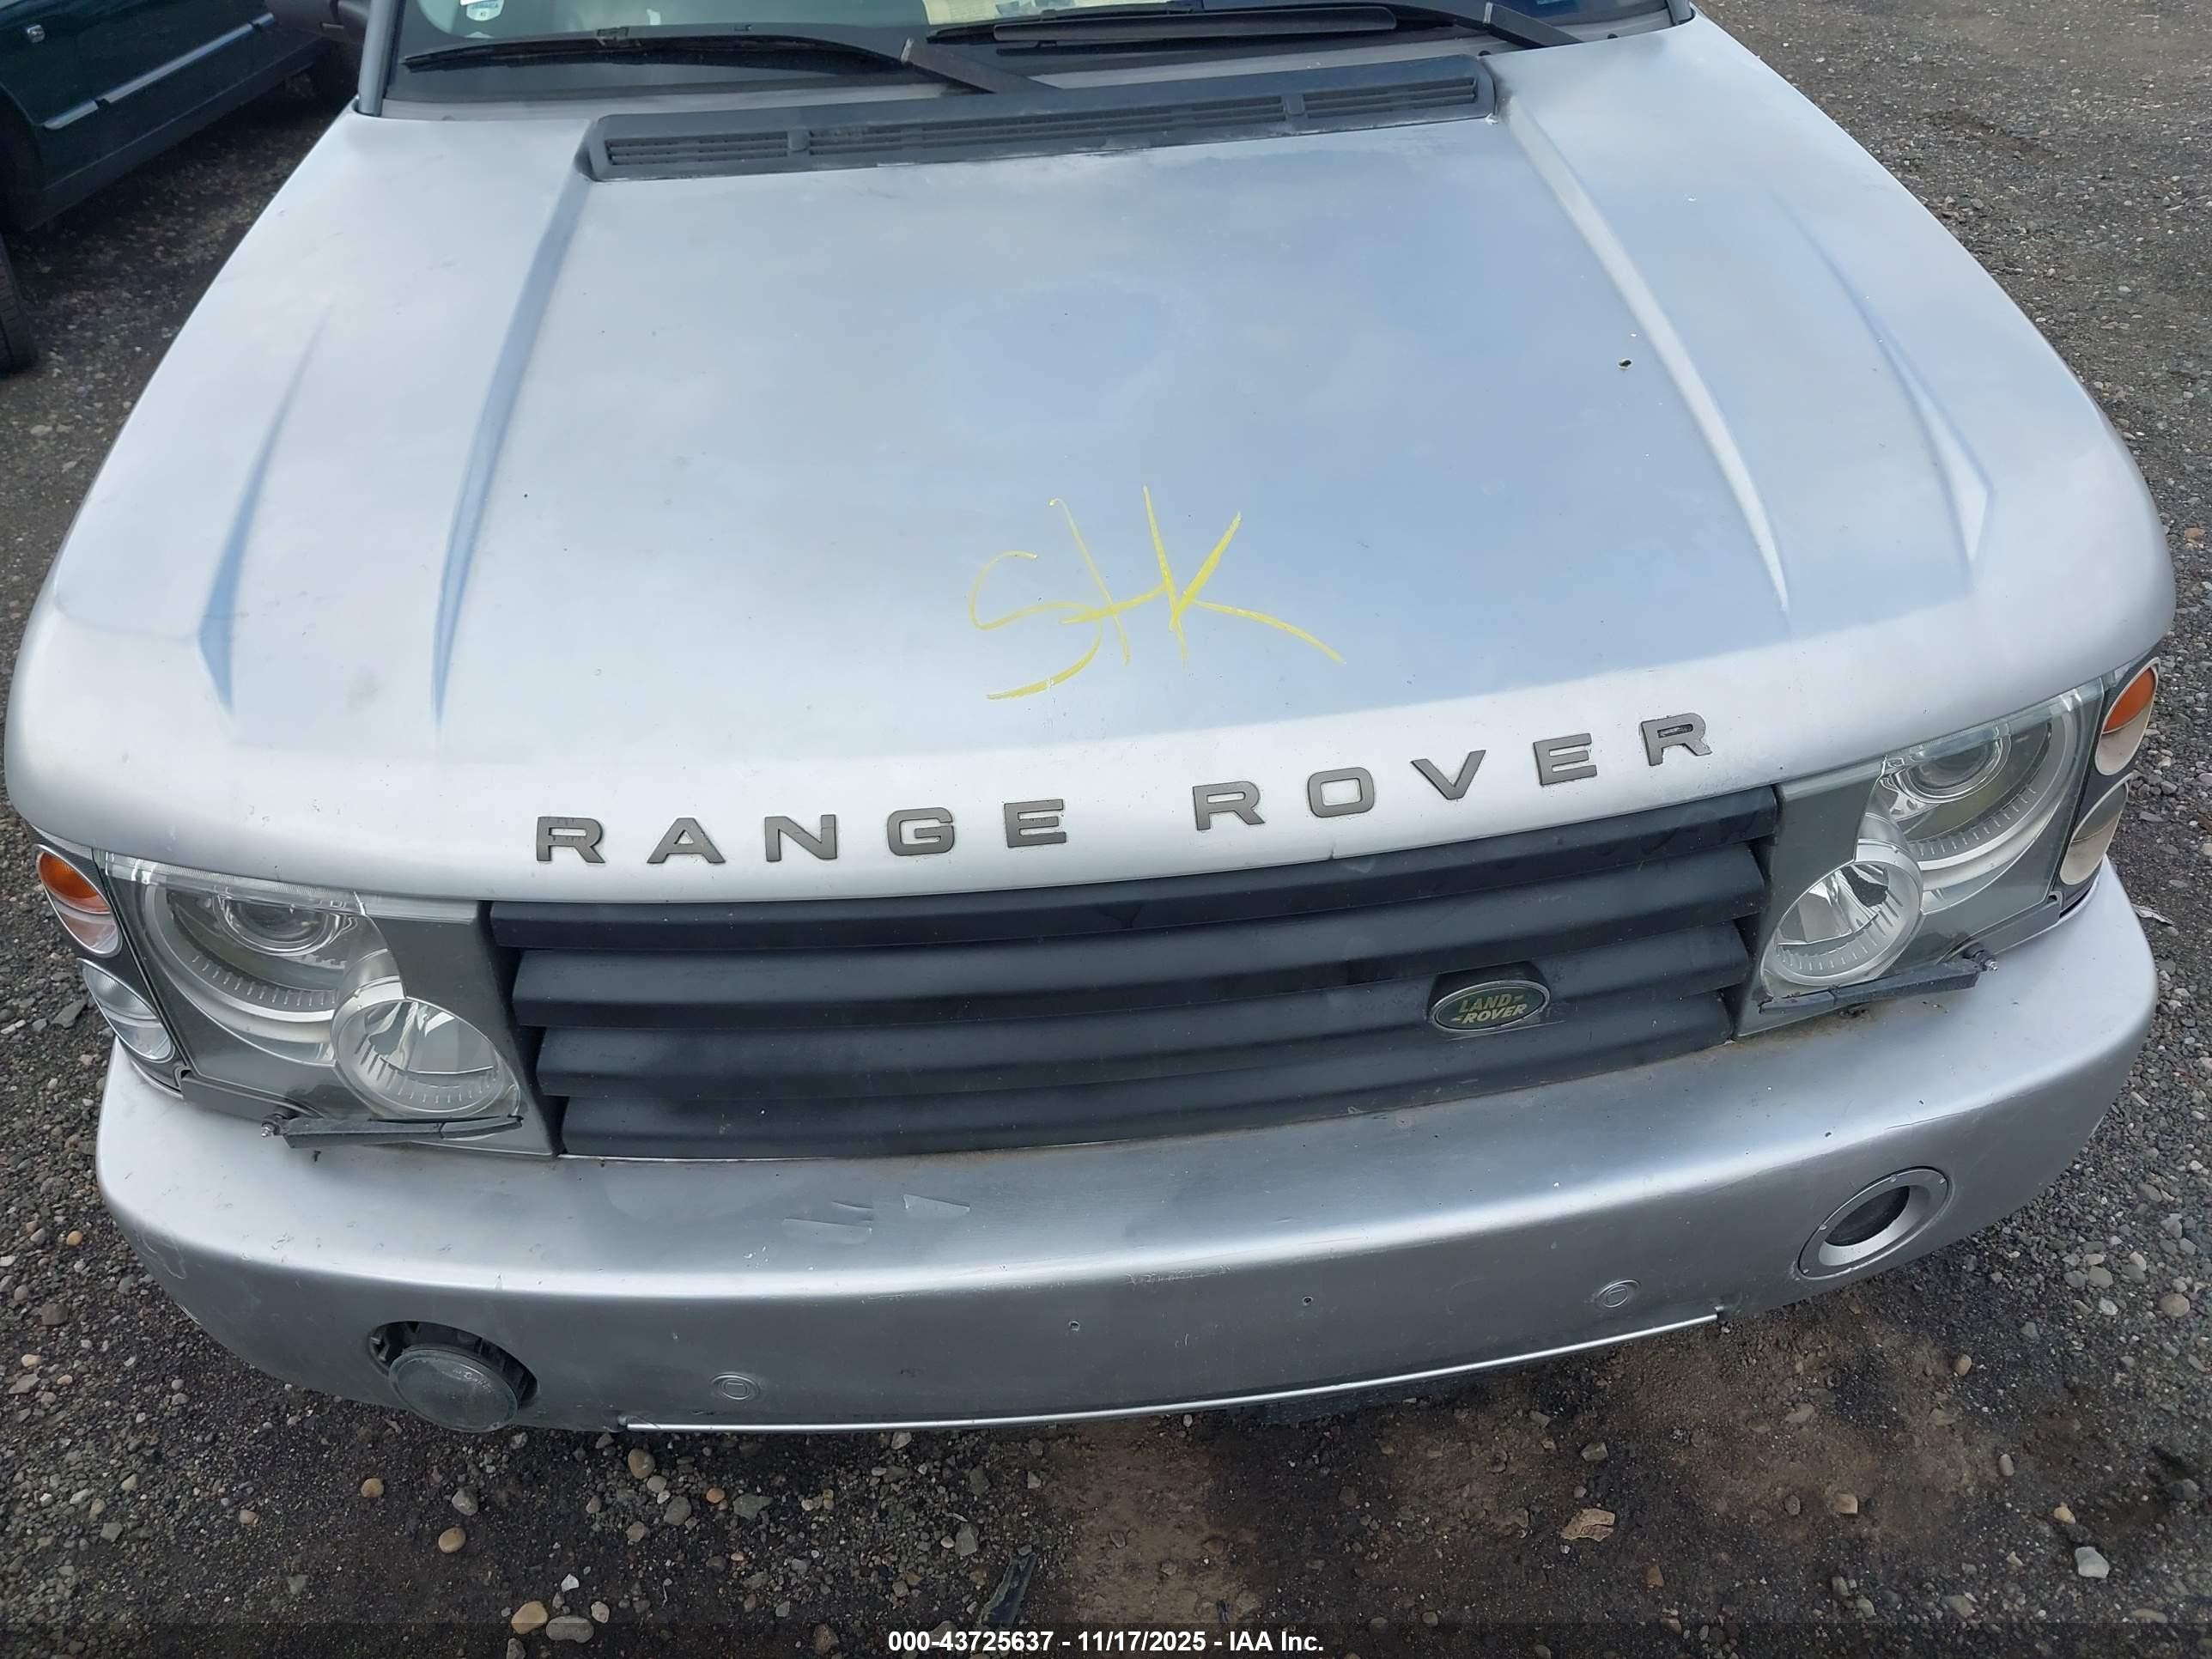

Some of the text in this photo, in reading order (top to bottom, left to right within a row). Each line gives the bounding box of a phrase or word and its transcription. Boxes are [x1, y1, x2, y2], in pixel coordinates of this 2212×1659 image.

[536, 712, 1713, 864] RANGE ROVER
[1460, 994, 1512, 1012] LAND
[1462, 1003, 1528, 1024] ROVER
